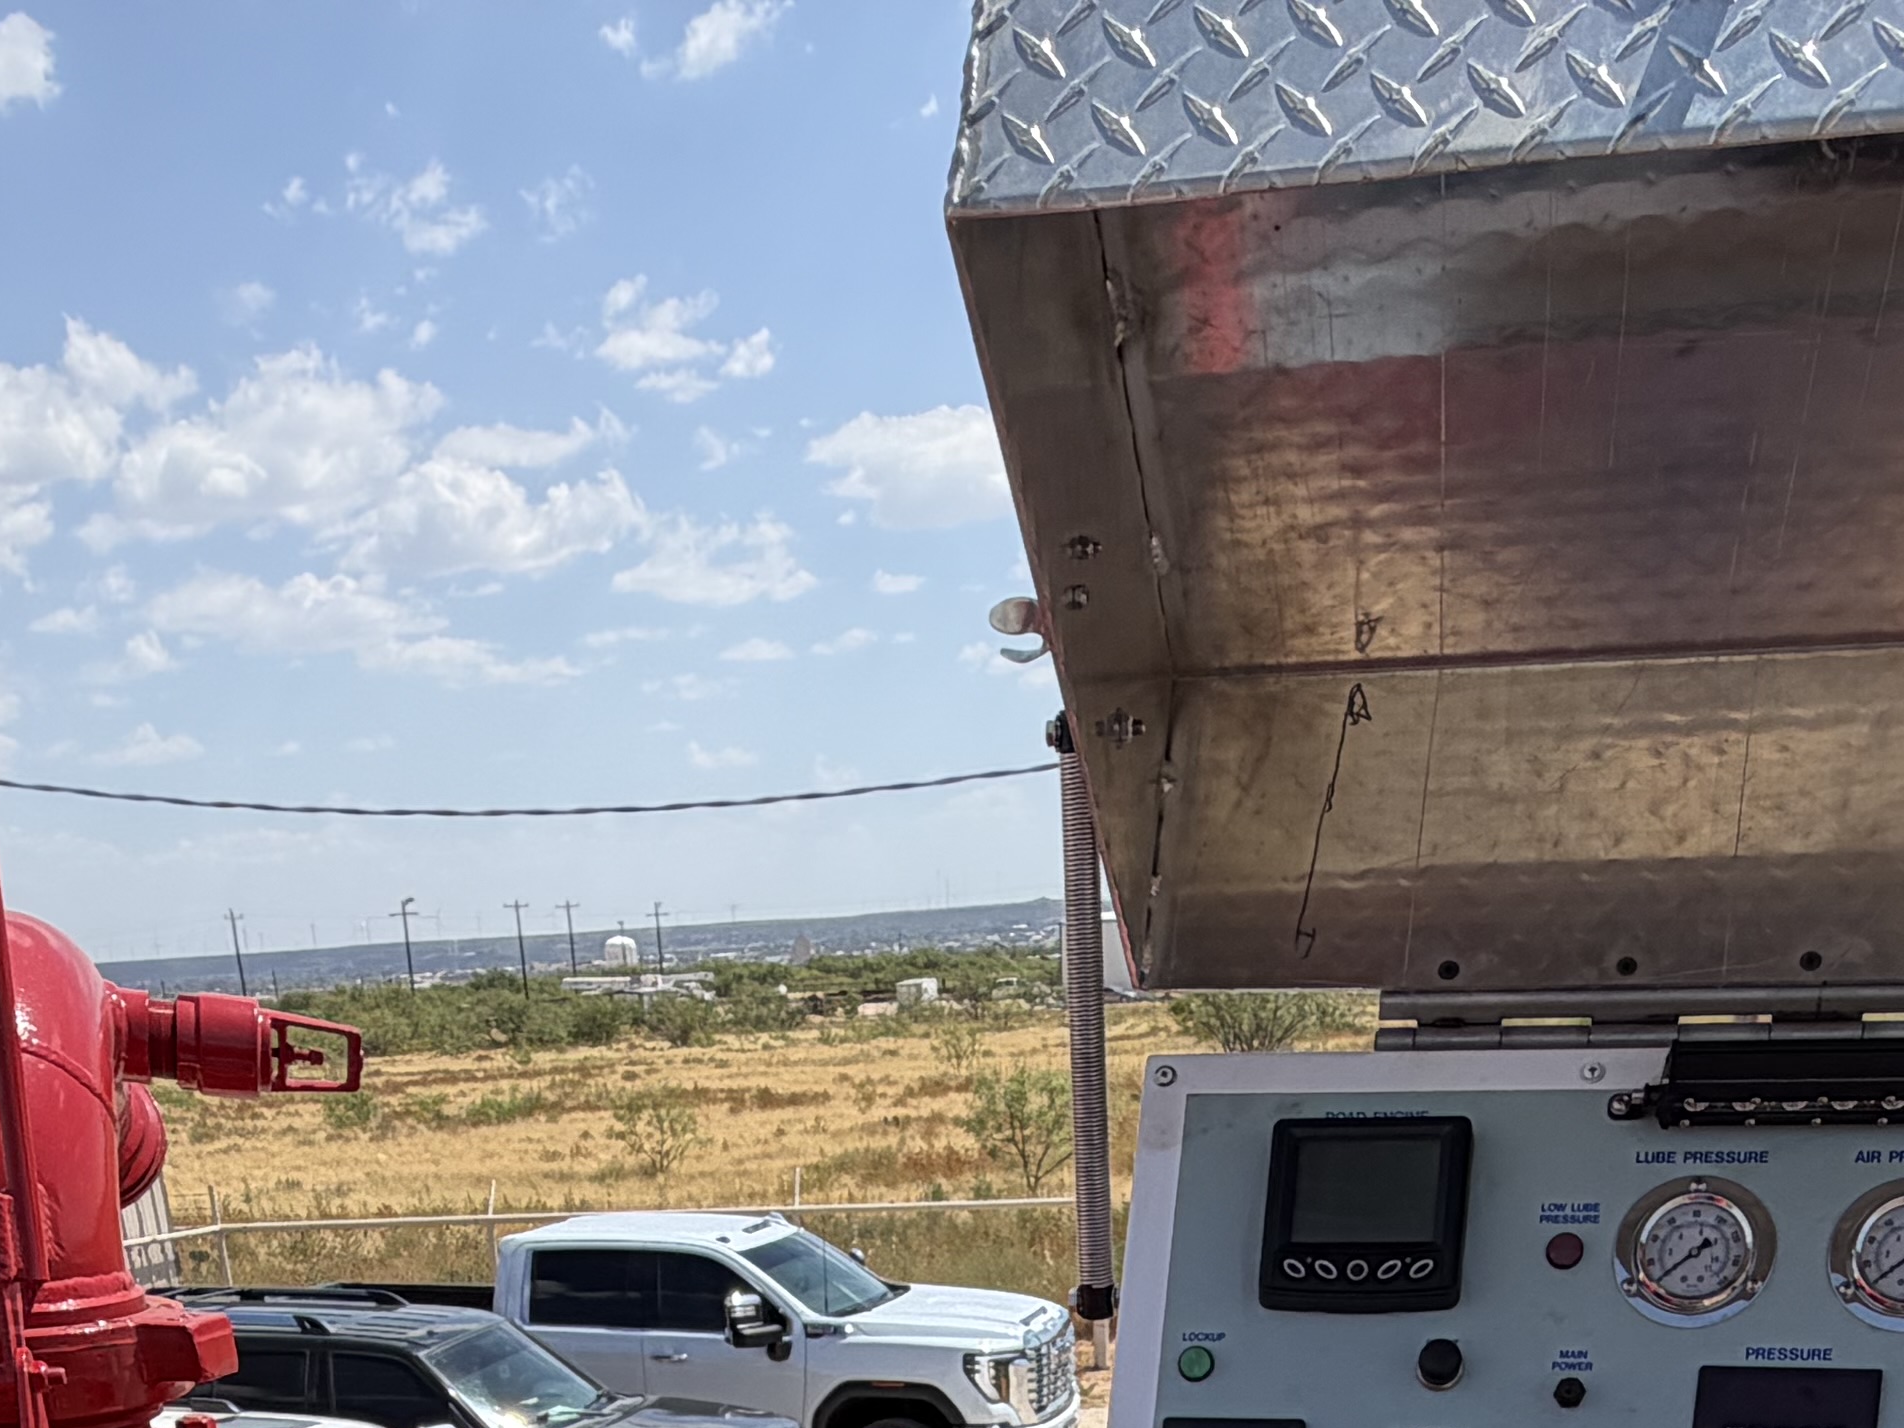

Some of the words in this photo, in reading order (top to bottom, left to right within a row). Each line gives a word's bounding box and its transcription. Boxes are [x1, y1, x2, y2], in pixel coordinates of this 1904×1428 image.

[1635, 1151, 1677, 1164] LUBE
[1683, 1151, 1769, 1164] PRESSURE
[1854, 1150, 1881, 1163] AIR
[1541, 1203, 1567, 1213] LOW
[1571, 1203, 1600, 1213] LUBE
[1539, 1214, 1600, 1224] PRESSURE
[1182, 1332, 1226, 1342] LOCKUP
[1559, 1350, 1588, 1359] MAIN
[1745, 1347, 1833, 1361] PRESSURE
[1552, 1361, 1593, 1371] POWER
